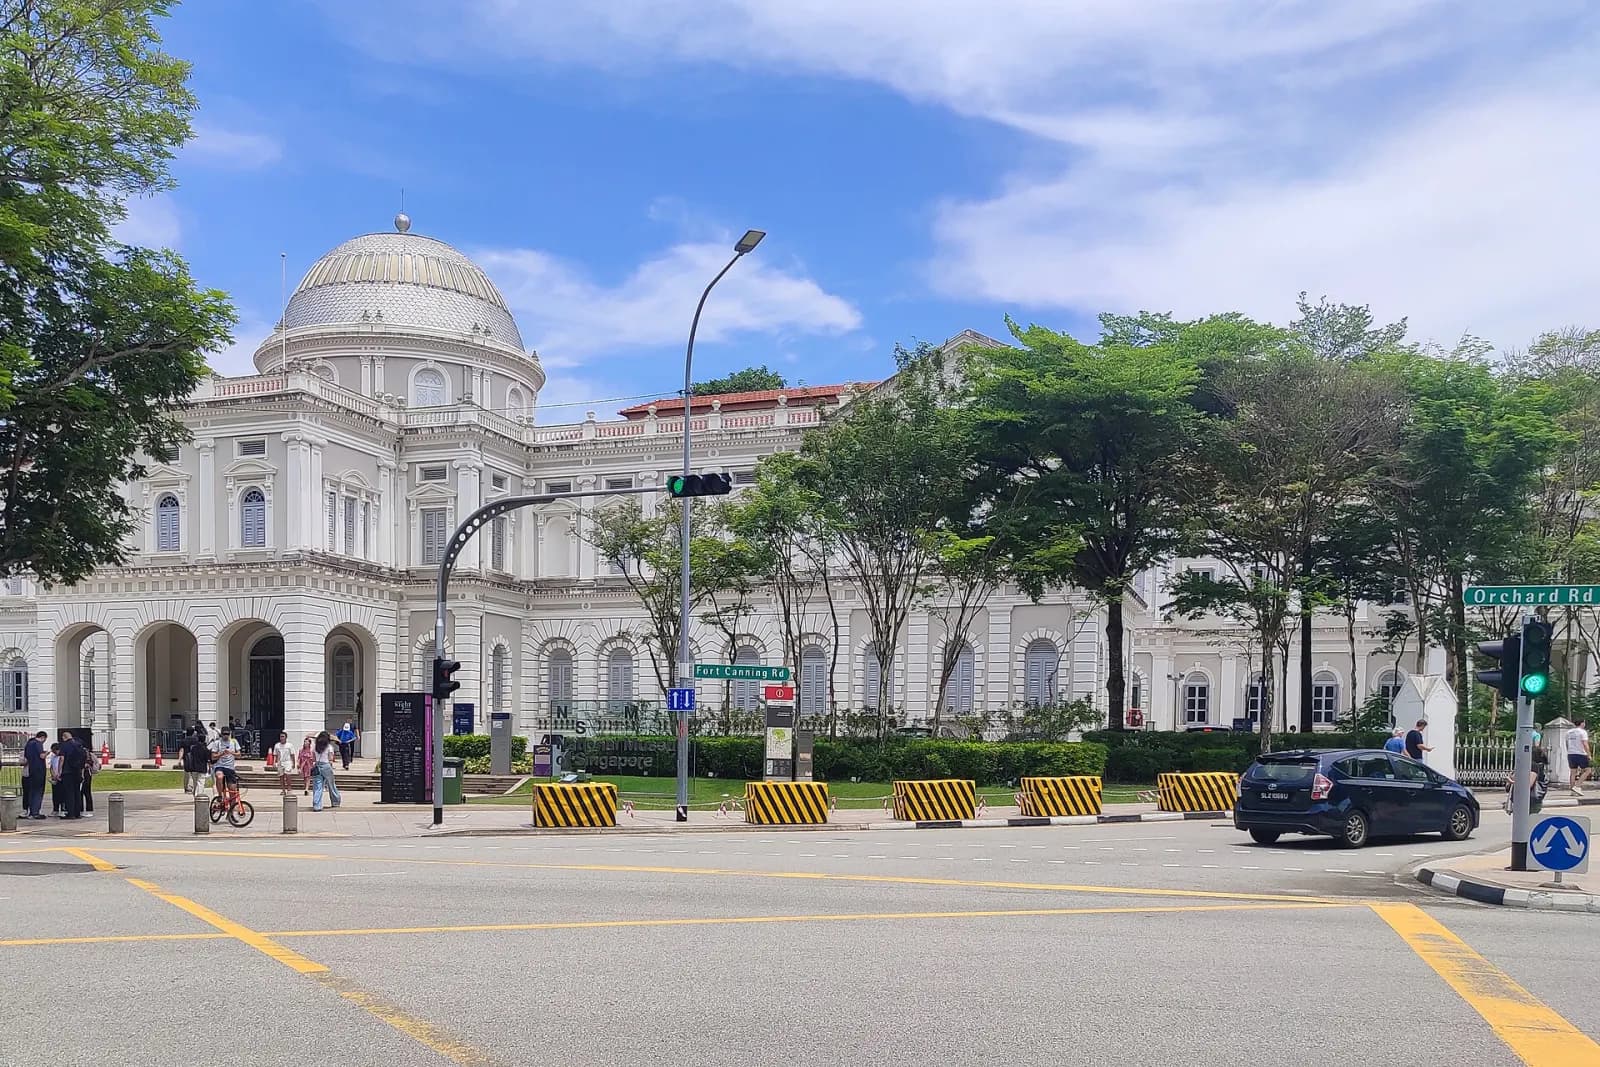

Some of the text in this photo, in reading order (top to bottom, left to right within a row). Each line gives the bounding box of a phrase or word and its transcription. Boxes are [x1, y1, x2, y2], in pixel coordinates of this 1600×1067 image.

[1474, 588, 1593, 603] Orchard Rd
[696, 666, 784, 679] Fort Canning Rd
[575, 752, 653, 769] Singapore
